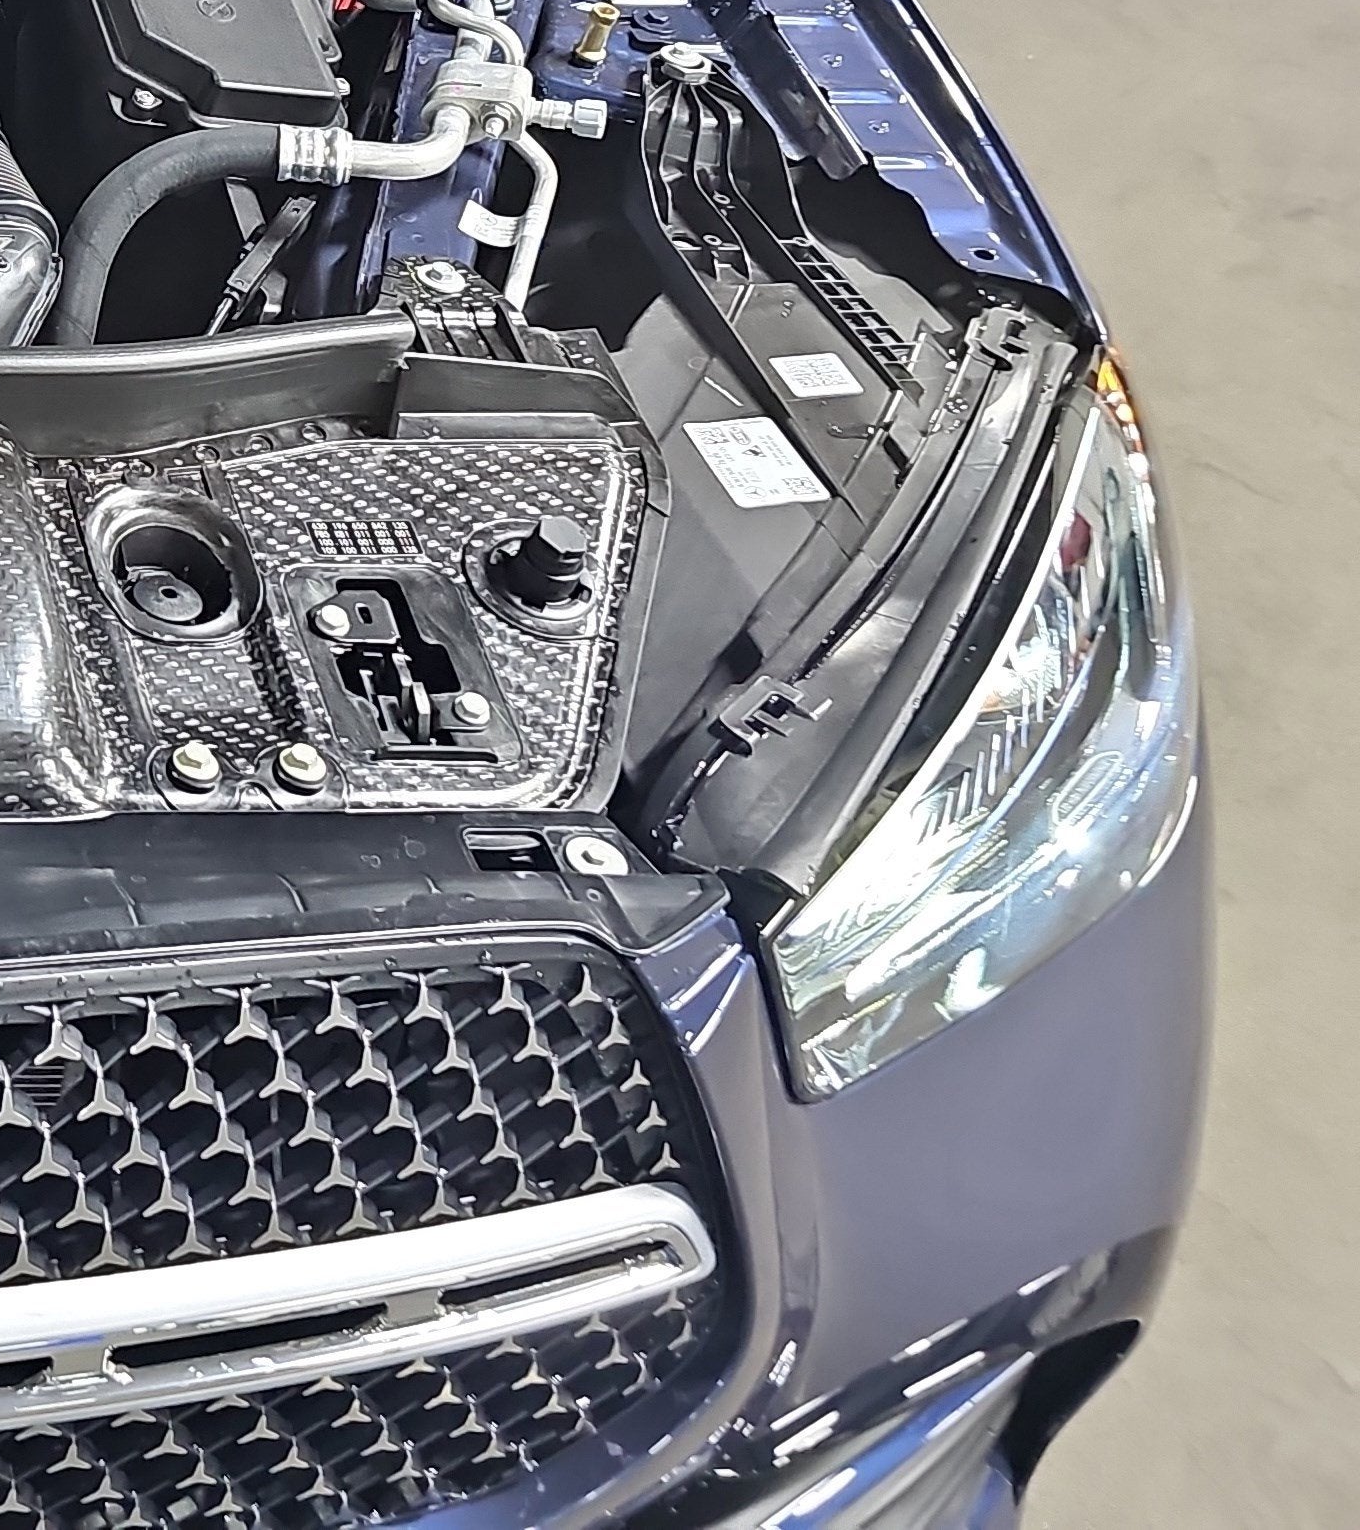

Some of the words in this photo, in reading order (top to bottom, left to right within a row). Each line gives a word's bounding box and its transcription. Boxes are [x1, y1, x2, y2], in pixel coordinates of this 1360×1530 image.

[354, 530, 371, 538] 011
[374, 530, 391, 538] 001
[394, 530, 411, 538] 001
[317, 538, 334, 546] 100
[337, 538, 354, 546] 101
[357, 538, 374, 546] 001
[377, 538, 395, 546] 000
[398, 538, 414, 546] 111
[320, 546, 338, 554] 100
[341, 546, 358, 554] 100
[360, 546, 377, 554] 011
[380, 546, 398, 554] 000
